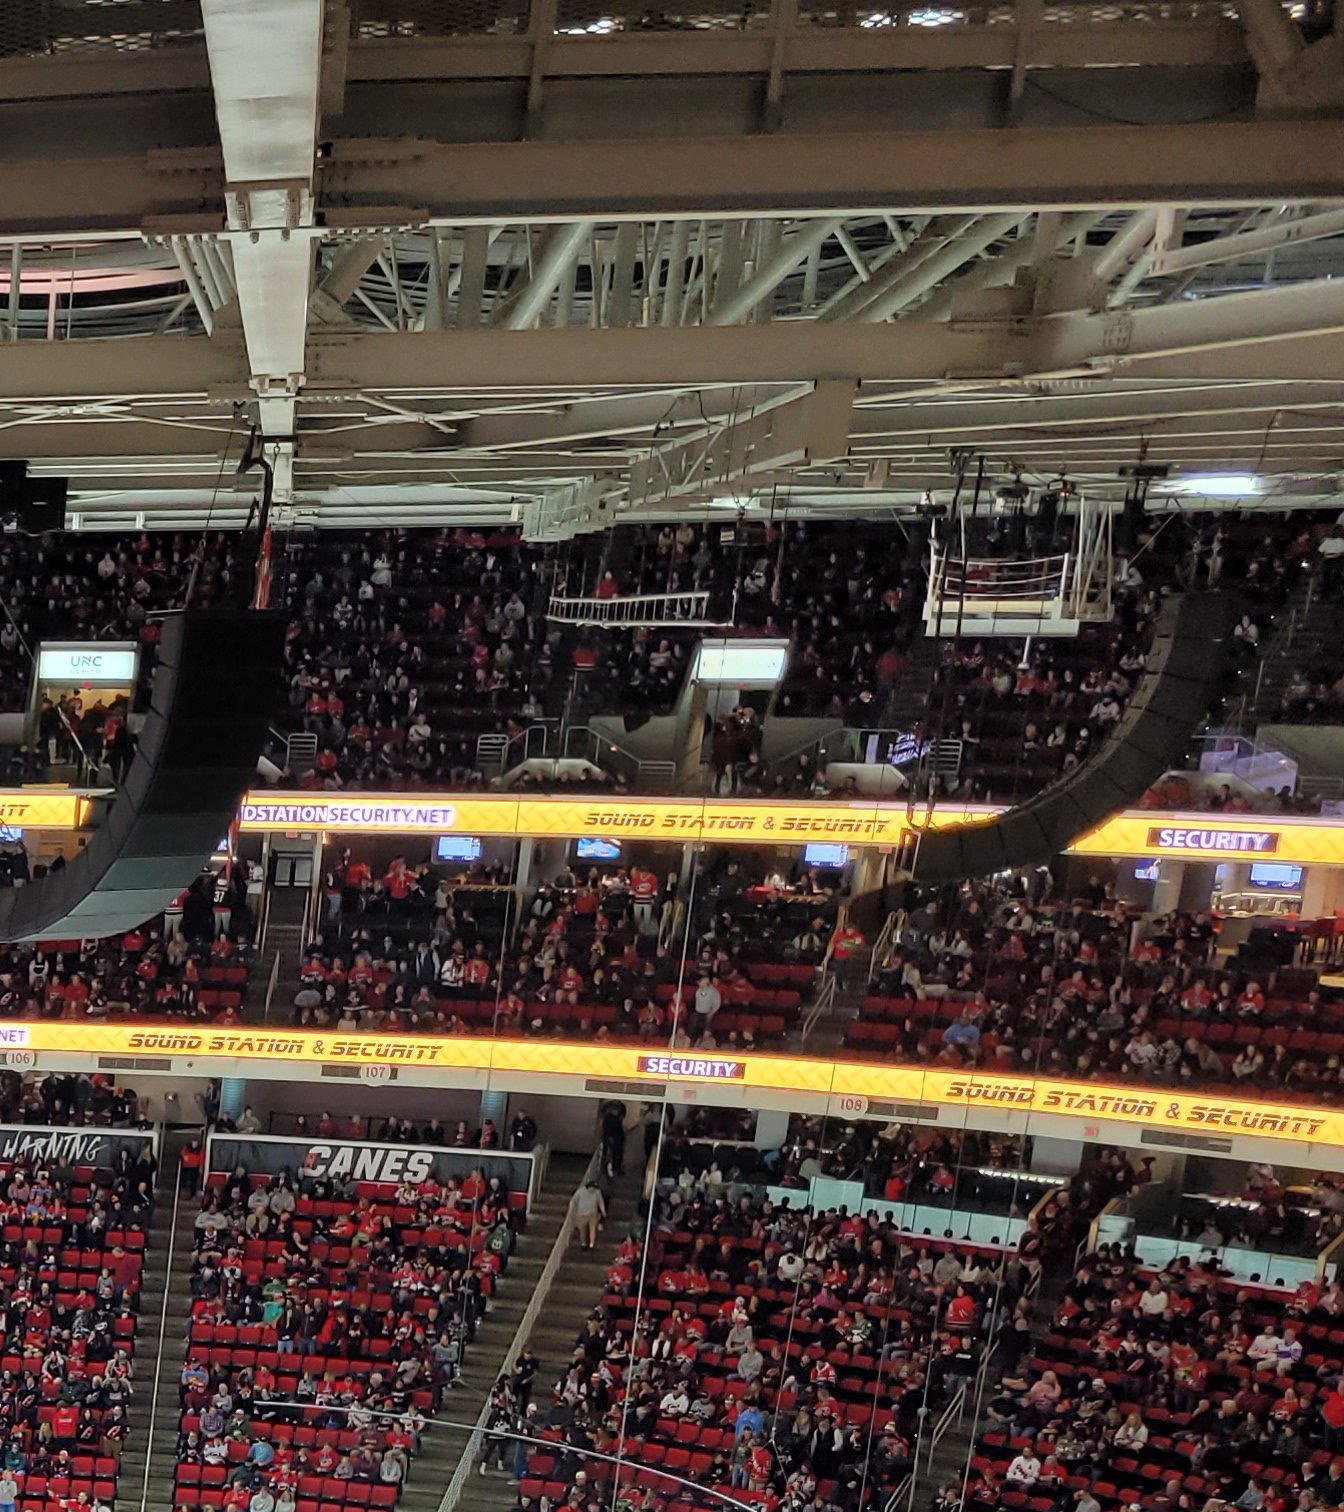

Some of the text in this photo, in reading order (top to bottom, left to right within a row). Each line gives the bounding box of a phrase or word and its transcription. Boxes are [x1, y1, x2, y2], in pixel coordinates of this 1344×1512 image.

[71, 655, 103, 667] UNC
[584, 812, 891, 834] SOUND STATION & SECURITY
[1158, 828, 1270, 851] SECURITY
[128, 1033, 443, 1060] SOUND STATION & SECURITY
[365, 1066, 386, 1078] 107
[646, 1057, 736, 1077] SECURITY
[839, 1098, 863, 1112] 108
[945, 1081, 1326, 1135] SOUND STATION & SECURITY
[2, 1130, 109, 1164] WARNING
[303, 1145, 434, 1184] CANES
